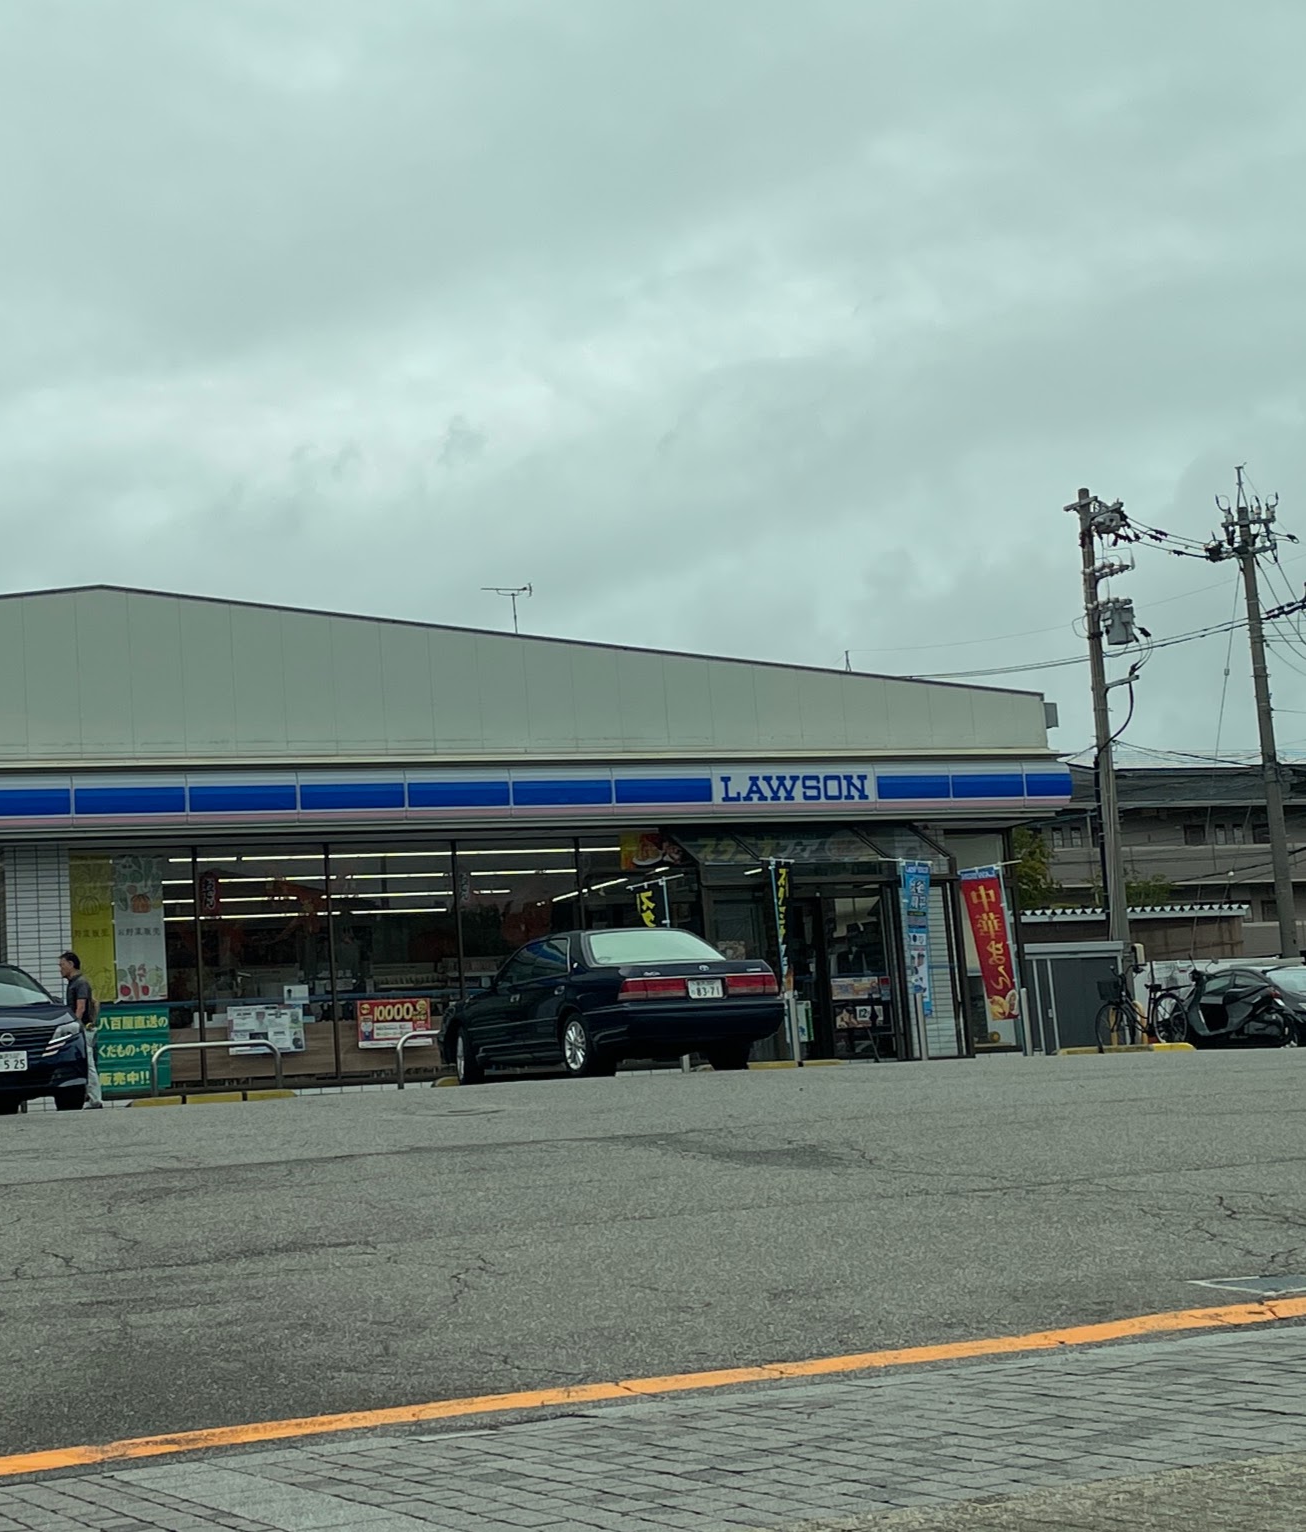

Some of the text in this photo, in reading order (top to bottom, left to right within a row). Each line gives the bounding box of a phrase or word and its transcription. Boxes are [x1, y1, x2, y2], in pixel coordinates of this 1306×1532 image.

[720, 775, 869, 802] LAWSON
[97, 1014, 168, 1031] 八百屋直送の
[98, 1042, 164, 1058] くだもの・やさ
